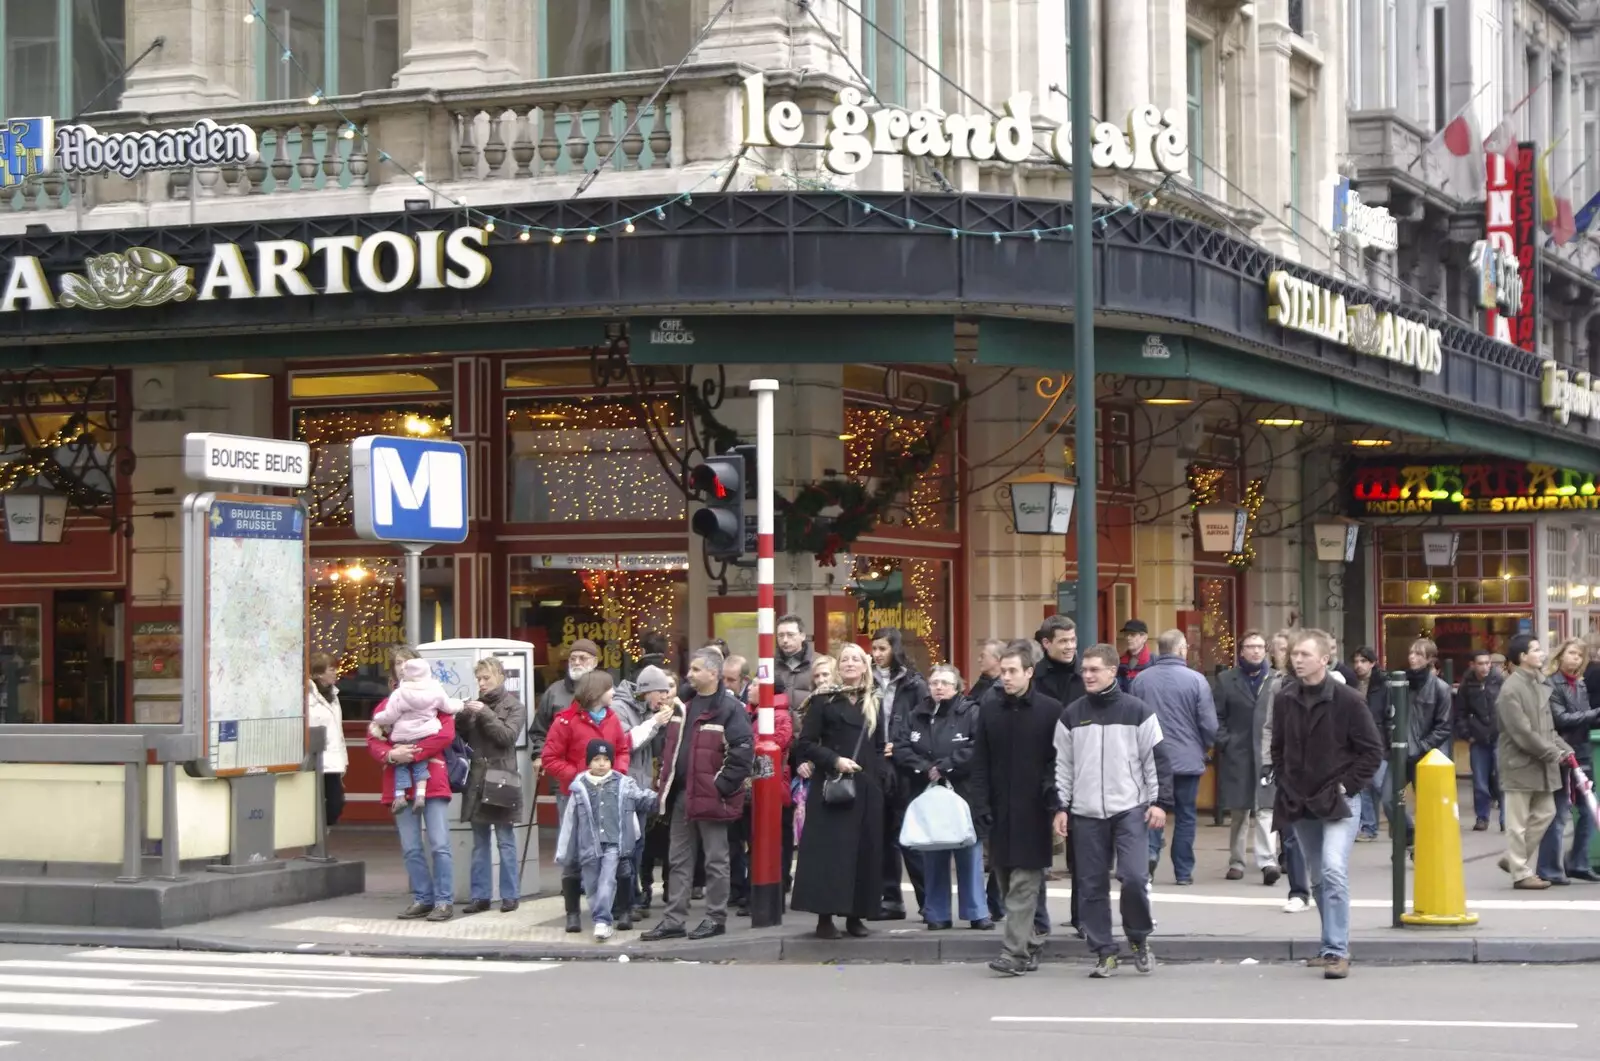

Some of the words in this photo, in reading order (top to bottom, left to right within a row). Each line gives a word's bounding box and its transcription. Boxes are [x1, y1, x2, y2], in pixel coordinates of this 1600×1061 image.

[743, 73, 806, 147] le
[824, 86, 1034, 176] grand
[58, 120, 250, 177] Hoegaarden
[197, 226, 492, 300] ARTOIS
[1268, 270, 1349, 345] STELLA
[1379, 311, 1443, 376] ARTOIS
[211, 448, 260, 470] BOURSE
[265, 453, 303, 474] BEURS
[373, 446, 463, 529] M
[1366, 500, 1433, 514] INDIAN
[231, 509, 283, 521] BRUXELLES
[236, 520, 278, 531] BRUSSEL
[562, 616, 631, 648] grand
